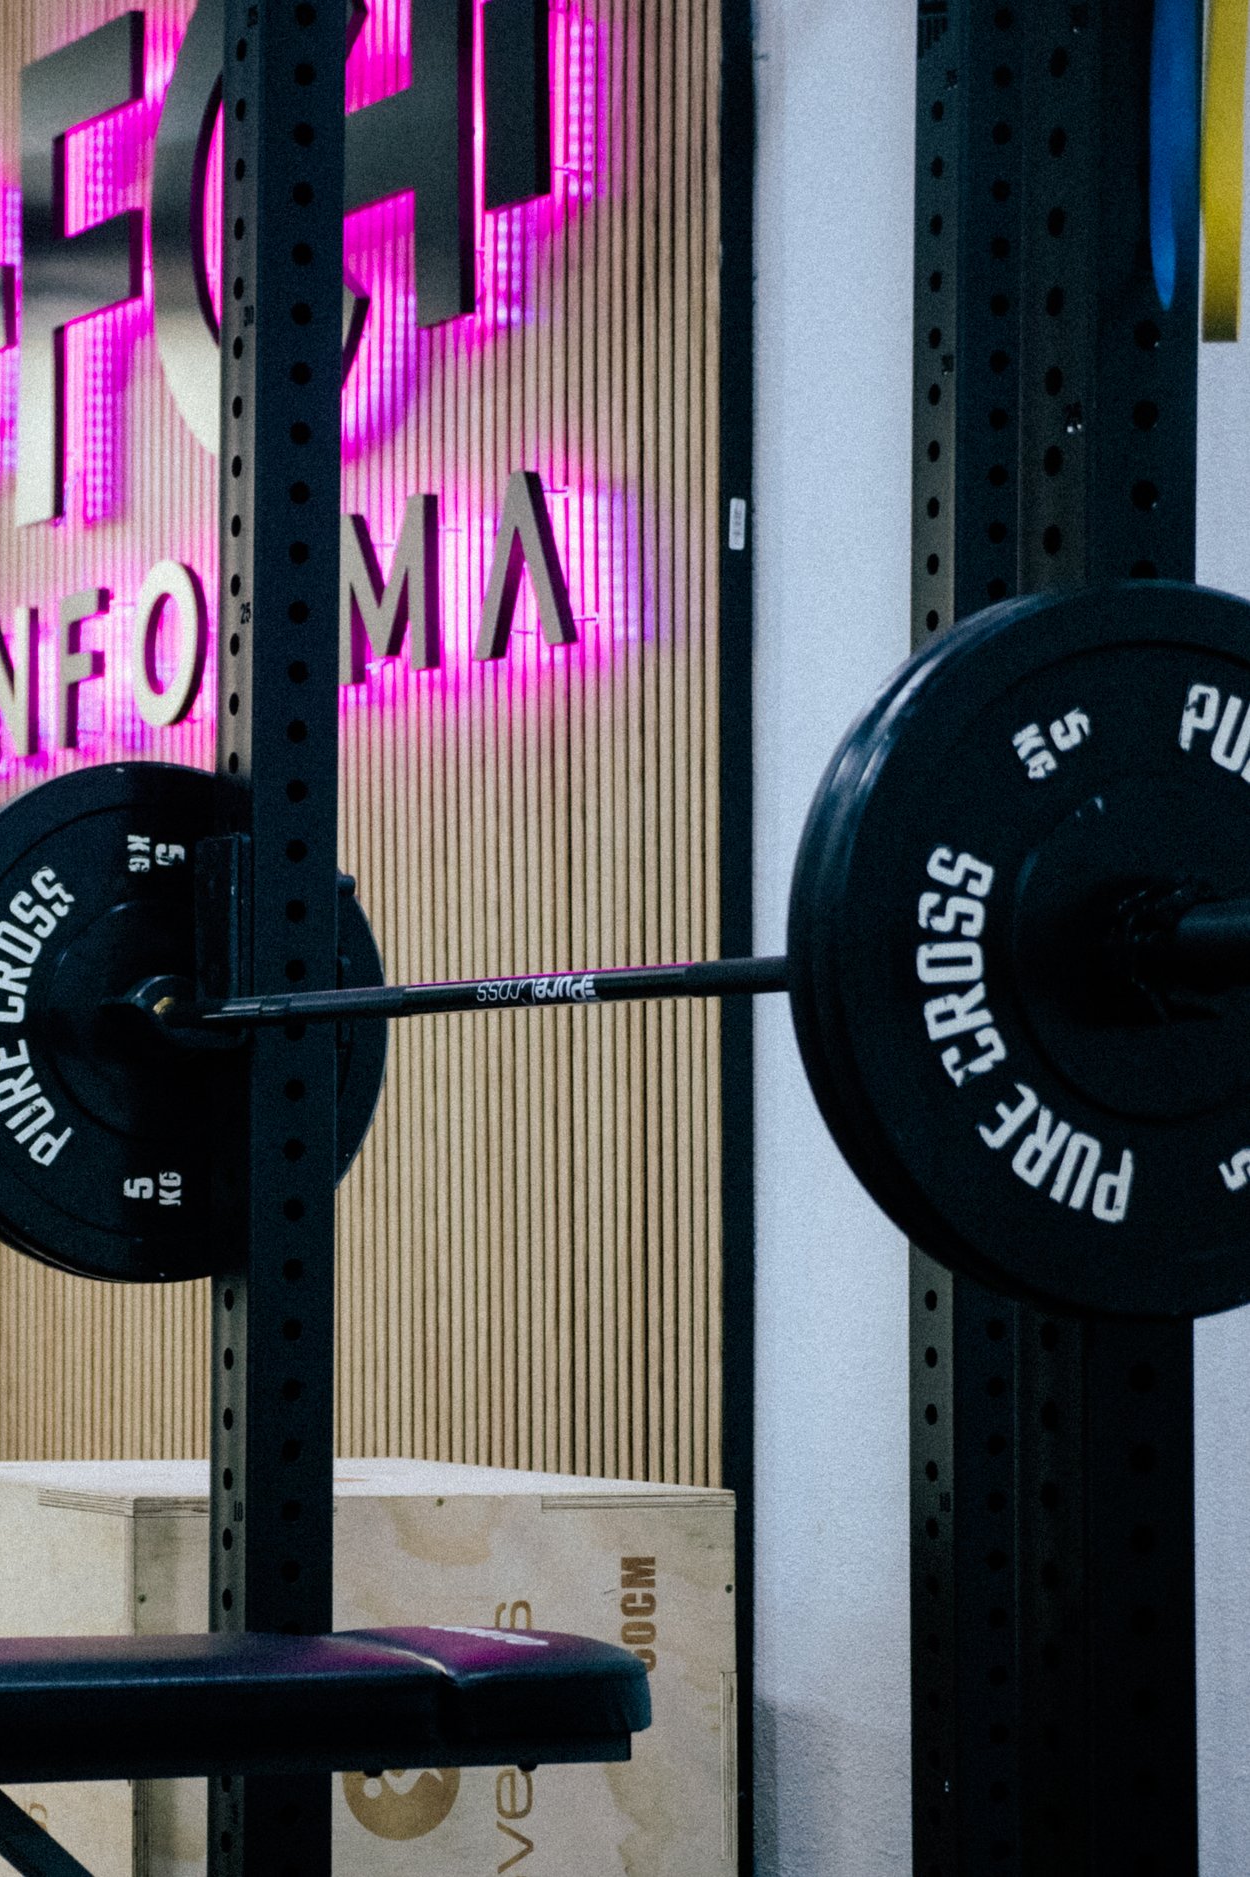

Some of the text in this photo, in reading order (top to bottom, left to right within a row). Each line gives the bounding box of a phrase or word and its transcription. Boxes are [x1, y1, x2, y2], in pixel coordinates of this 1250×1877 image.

[240, 601, 251, 624] 25
[1050, 707, 1092, 752] 5
[1179, 683, 1250, 784] PU
[1011, 723, 1058, 780] KG
[126, 833, 151, 873] KG
[154, 842, 186, 867] 5
[917, 846, 1134, 1223] PURE CROSS
[122, 1176, 155, 1200] 5
[158, 1171, 182, 1206] KG
